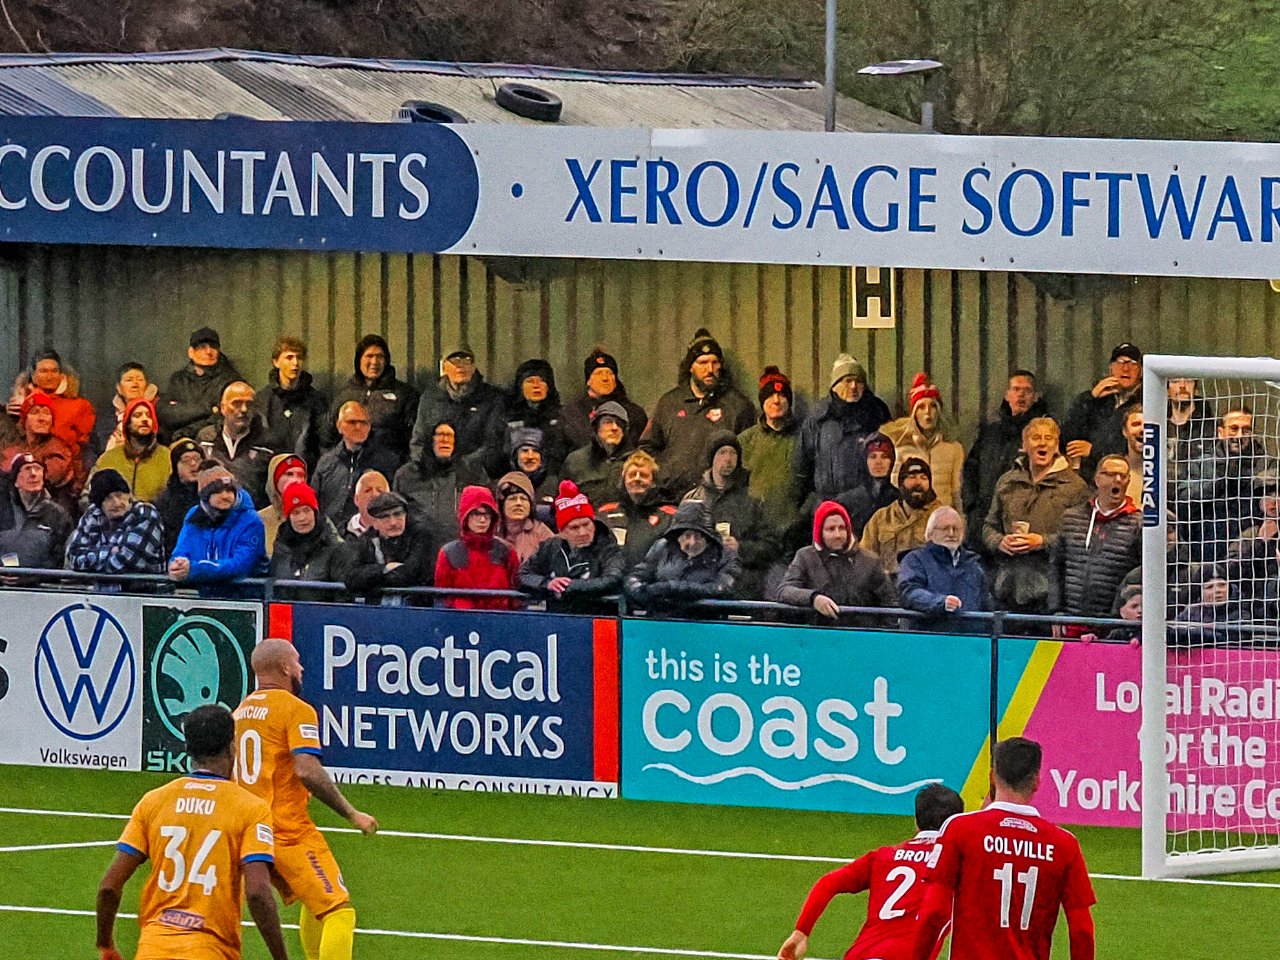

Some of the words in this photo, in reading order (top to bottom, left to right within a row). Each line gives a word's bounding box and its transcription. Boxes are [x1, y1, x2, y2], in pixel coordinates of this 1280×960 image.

[0, 144, 430, 220] CCOUNTANTS
[564, 157, 937, 233] XERO/SAGE
[856, 266, 891, 317] H
[1143, 428, 1156, 508] FORZA
[323, 624, 561, 703] Practical
[645, 648, 704, 683] this
[714, 652, 738, 684] is
[749, 653, 801, 687] the
[641, 675, 907, 765] coast
[1096, 672, 1191, 716] Loal
[40, 747, 128, 769] Volkswagen
[322, 704, 565, 759] NETWORKS
[1201, 725, 1267, 768] the
[176, 797, 216, 815] DUKU
[1050, 768, 1236, 815] Yorkhire
[158, 825, 222, 896] 34
[983, 835, 1055, 862] COLVILLE
[993, 862, 1039, 931] 11
